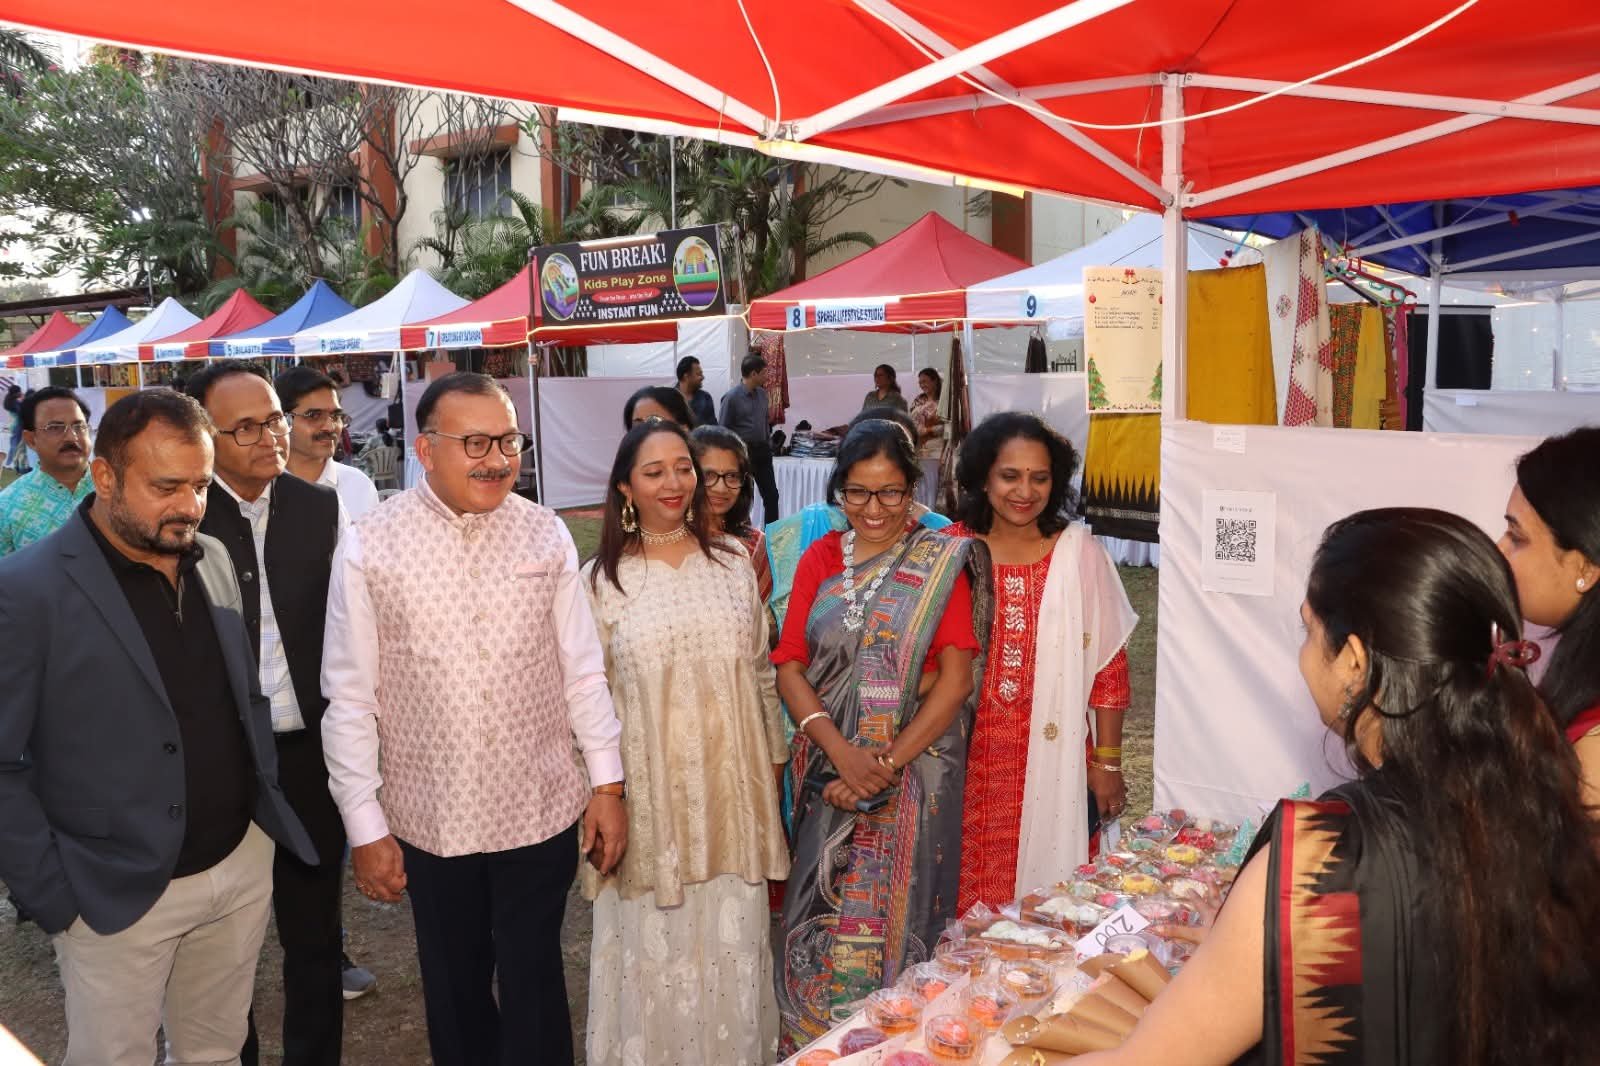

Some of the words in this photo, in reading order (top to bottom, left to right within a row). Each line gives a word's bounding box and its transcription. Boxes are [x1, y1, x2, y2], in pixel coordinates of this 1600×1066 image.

[580, 251, 608, 272] FUN
[612, 243, 666, 268] BREAK!
[584, 279, 608, 290] Kids
[611, 276, 634, 288] Play
[638, 273, 667, 284] Zone
[598, 305, 637, 320] INSTANT
[638, 304, 658, 316] FUN
[864, 307, 883, 321] STUDIO
[1026, 295, 1037, 318] 9
[792, 307, 801, 327] 8
[430, 331, 435, 346] 7
